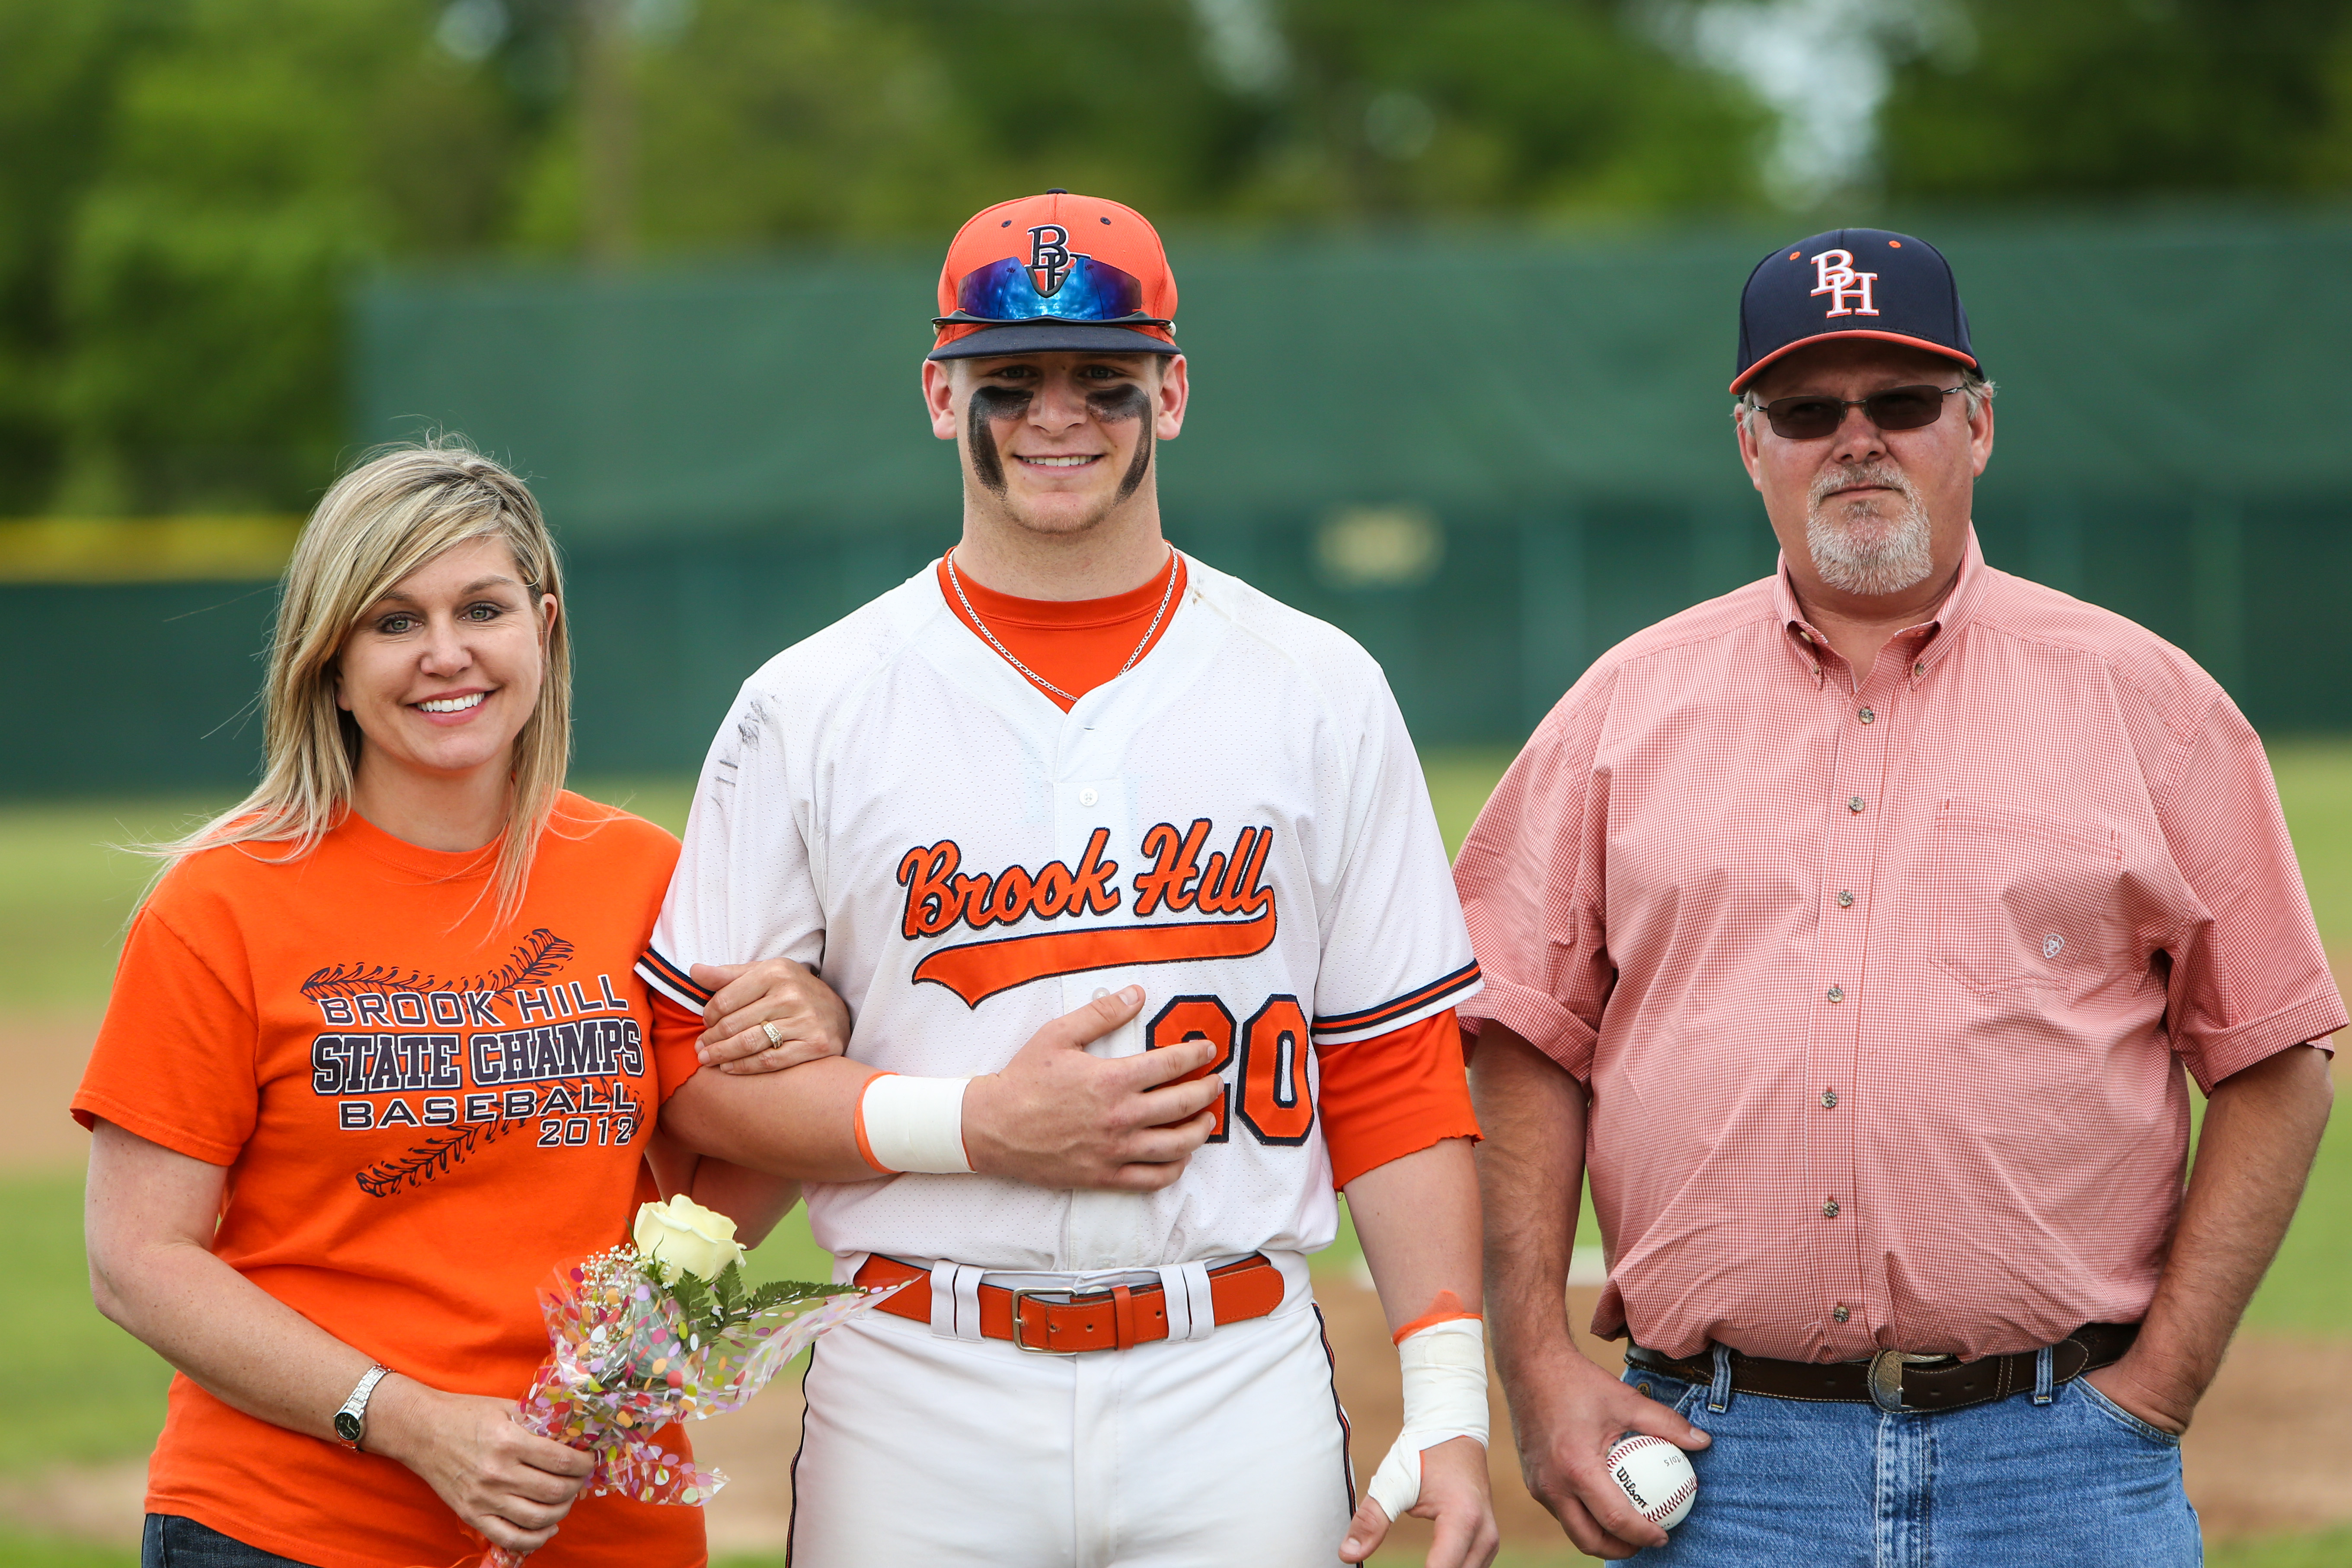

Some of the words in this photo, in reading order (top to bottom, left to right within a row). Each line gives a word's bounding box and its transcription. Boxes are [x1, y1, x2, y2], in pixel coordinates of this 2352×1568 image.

[1811, 249, 1879, 318] BH
[897, 827, 1121, 940] Brook
[1133, 818, 1275, 917] Hill
[317, 990, 506, 1027] BROOK
[518, 974, 629, 1024] HILL
[311, 1032, 463, 1095] STATE
[468, 1017, 645, 1087] CHAMPS
[339, 1083, 636, 1130] BASEBALL
[537, 1117, 633, 1148] 2012
[1617, 1466, 1649, 1510] Wilson
